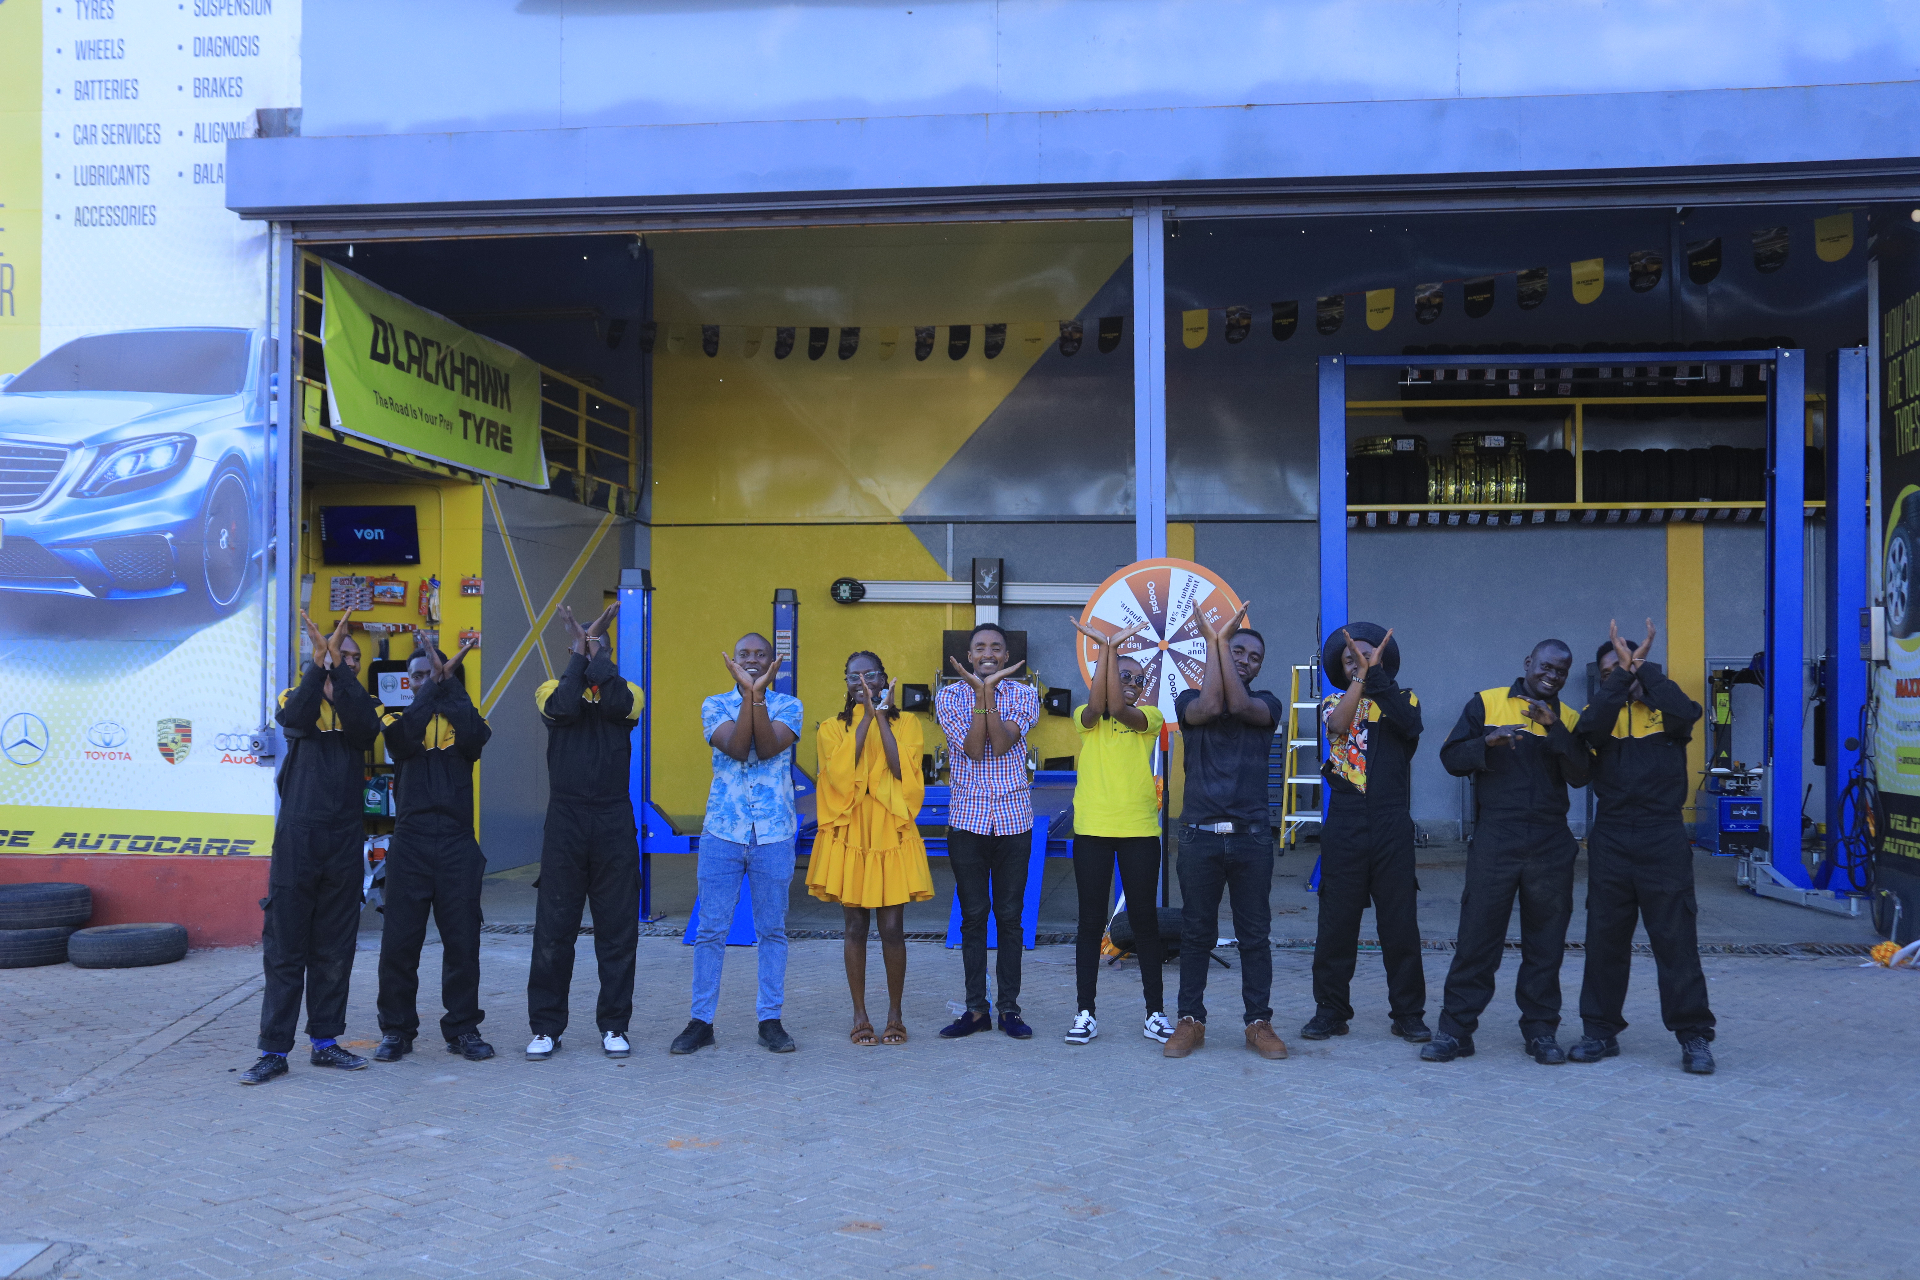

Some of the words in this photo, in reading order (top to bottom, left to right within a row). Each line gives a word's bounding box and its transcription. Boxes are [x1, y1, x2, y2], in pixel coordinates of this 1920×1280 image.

[193, 0, 271, 17] SUSPENSION
[75, 38, 125, 61] WHEELS
[193, 35, 260, 57] DIAGNOSIS
[74, 78, 139, 101] BATTERIES
[193, 76, 243, 98] BRAKES
[73, 124, 97, 145] CAR
[101, 123, 161, 145] SERVICES
[193, 121, 246, 143] ALIGNM
[73, 164, 150, 186] LUBRICANTS
[193, 162, 224, 184] BALA
[74, 205, 156, 227] ACCESSORIES
[369, 312, 512, 414] BLACKHAWK
[373, 389, 389, 409] The
[388, 396, 410, 417] Road
[409, 403, 418, 420] Is
[418, 406, 438, 427] Your
[438, 413, 454, 435] Prey
[459, 409, 514, 455] TYRE
[353, 528, 385, 541] von
[1180, 574, 1194, 600] wheel
[1181, 580, 1200, 619] alignment
[1183, 619, 1198, 632] FRE
[1204, 606, 1218, 621] yre
[1127, 641, 1142, 650] day
[1187, 648, 1206, 656] anot
[1192, 641, 1205, 650] Try
[1177, 660, 1204, 686] inspecti
[400, 693, 415, 701] Inve
[1144, 675, 1158, 698] wheel
[1168, 673, 1178, 701] Ooop
[84, 751, 132, 762] TOYOTA
[52, 831, 256, 856] AUTOCARE
